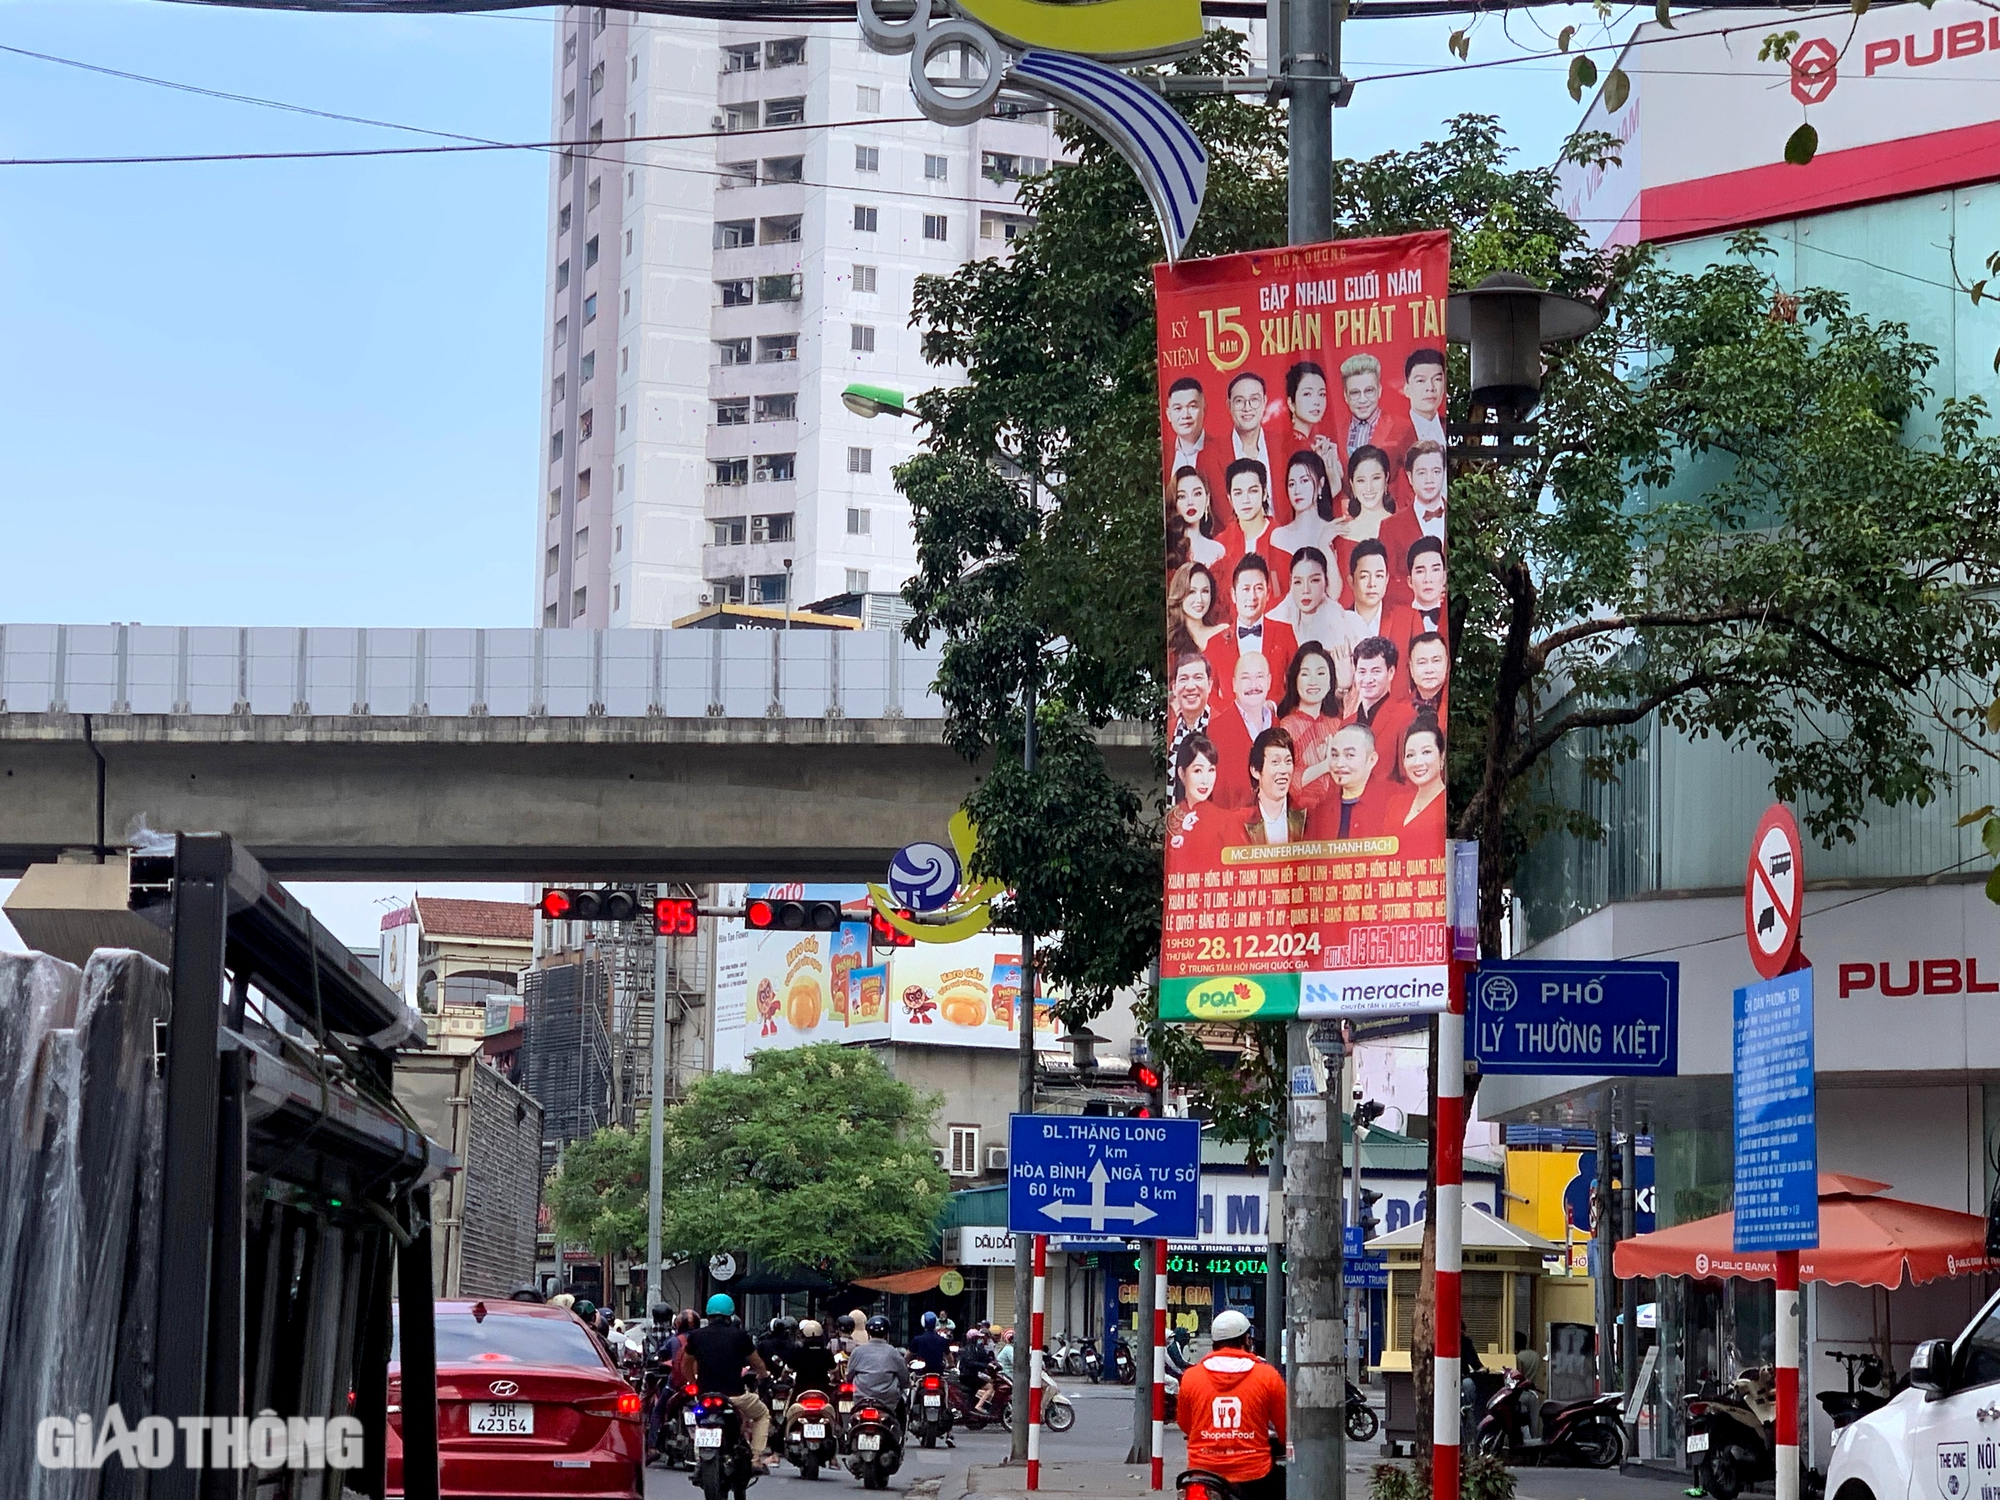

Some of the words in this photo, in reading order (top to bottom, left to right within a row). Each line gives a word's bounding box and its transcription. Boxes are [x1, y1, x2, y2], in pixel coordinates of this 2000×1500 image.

[1260, 283, 1290, 313] GẶP
[1296, 279, 1337, 306] NHAU
[1344, 270, 1380, 302] CUỐI
[1388, 268, 1422, 297] NĂM
[1171, 316, 1189, 339] KỶ
[1260, 309, 1322, 356] XUÂN
[1335, 302, 1396, 348] PHÁT
[1408, 294, 1446, 339] TÀI
[1198, 306, 1251, 371] 15
[1162, 348, 1200, 370] NIỆM
[1251, 845, 1292, 860] JENNIFER
[1292, 844, 1321, 858] PHẠM
[1328, 842, 1362, 854] THANH
[1166, 938, 1195, 948] 19H30
[1196, 932, 1322, 960] 28.12.2024
[1188, 964, 1215, 973] TRUNG
[1216, 963, 1232, 972] TÂM
[1234, 962, 1248, 972] HỘI
[1250, 962, 1269, 972] NGHỊ
[1271, 960, 1293, 970] QUỐC
[1295, 960, 1309, 969] GIA
[940, 970, 963, 983] Karo
[1838, 958, 2000, 998] PUBL
[1342, 978, 1444, 1001] meracine
[1542, 975, 1606, 1004] PHỐ
[1198, 990, 1237, 1008] PQA
[1482, 1016, 1504, 1052] LÝ
[1516, 1016, 1602, 1053] THƯỜNG
[1613, 1019, 1660, 1058] KIỆT
[1125, 1128, 1166, 1141] LONG
[1088, 1145, 1096, 1158] 7
[1105, 1146, 1128, 1158] km
[1013, 1161, 1044, 1178] HÒA
[1050, 1162, 1086, 1180] BÌNH
[1112, 1164, 1143, 1181] NGÃ
[1149, 1168, 1170, 1181] TƯ
[1175, 1163, 1196, 1182] SỞ
[1029, 1183, 1047, 1196] 60
[1053, 1184, 1075, 1197] km
[1140, 1186, 1148, 1199] 8
[1154, 1187, 1176, 1200] km
[1206, 1260, 1230, 1273] 412
[1712, 1261, 1742, 1270] PUBLIC
[1745, 1262, 1770, 1272] BANK
[1185, 1286, 1211, 1305] GIA
[489, 1404, 515, 1417] 30H
[478, 1419, 527, 1432] 423.64
[1201, 1430, 1254, 1441] ShopeeFood
[1939, 1453, 1951, 1468] THE
[1953, 1452, 1966, 1468] ONE
[1978, 1437, 1996, 1476] NỘI
